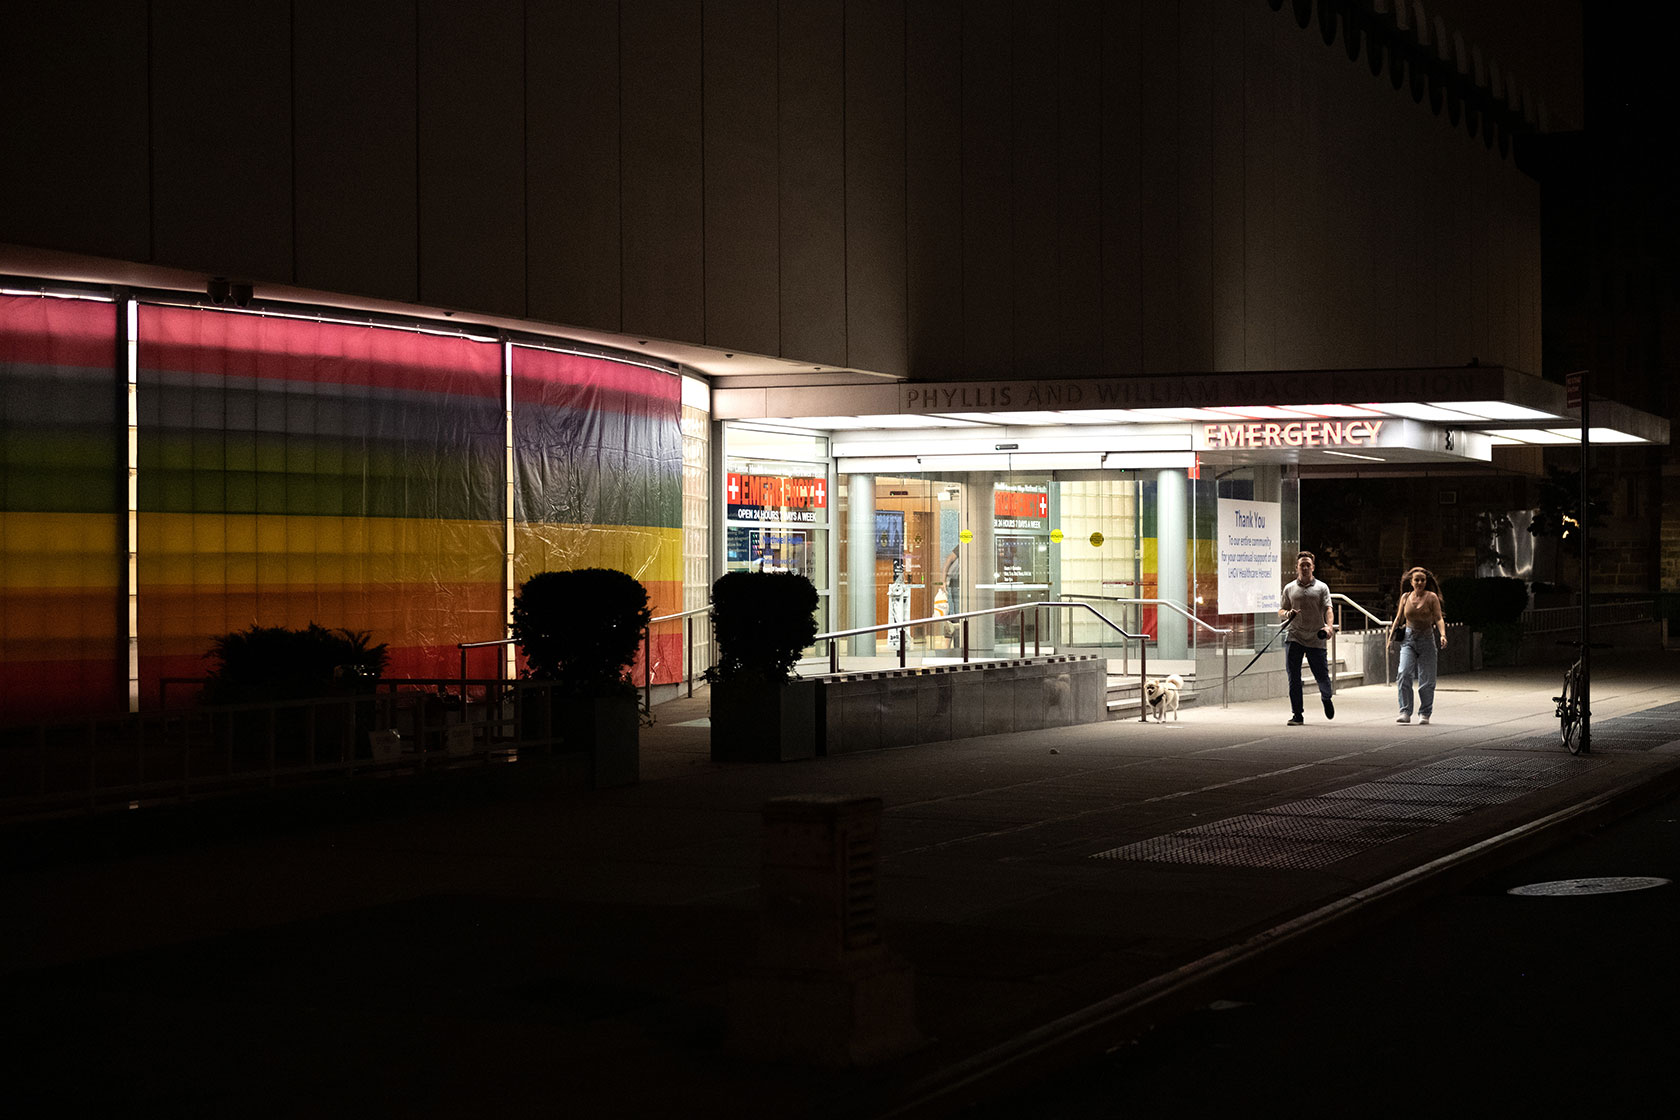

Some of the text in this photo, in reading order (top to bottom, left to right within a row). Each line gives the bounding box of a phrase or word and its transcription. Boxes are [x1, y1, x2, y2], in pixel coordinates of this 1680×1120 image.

[906, 375, 1474, 408] PHYLLIS AND WILLIAM MACK PAVILION
[1204, 421, 1384, 448] EMERGENCY
[741, 475, 815, 508] EMERGENCY
[738, 508, 753, 519] OPEN
[761, 510, 780, 521] HOURS
[802, 512, 817, 522] WEEK
[1235, 510, 1265, 528] Thank You
[1252, 536, 1271, 550] community
